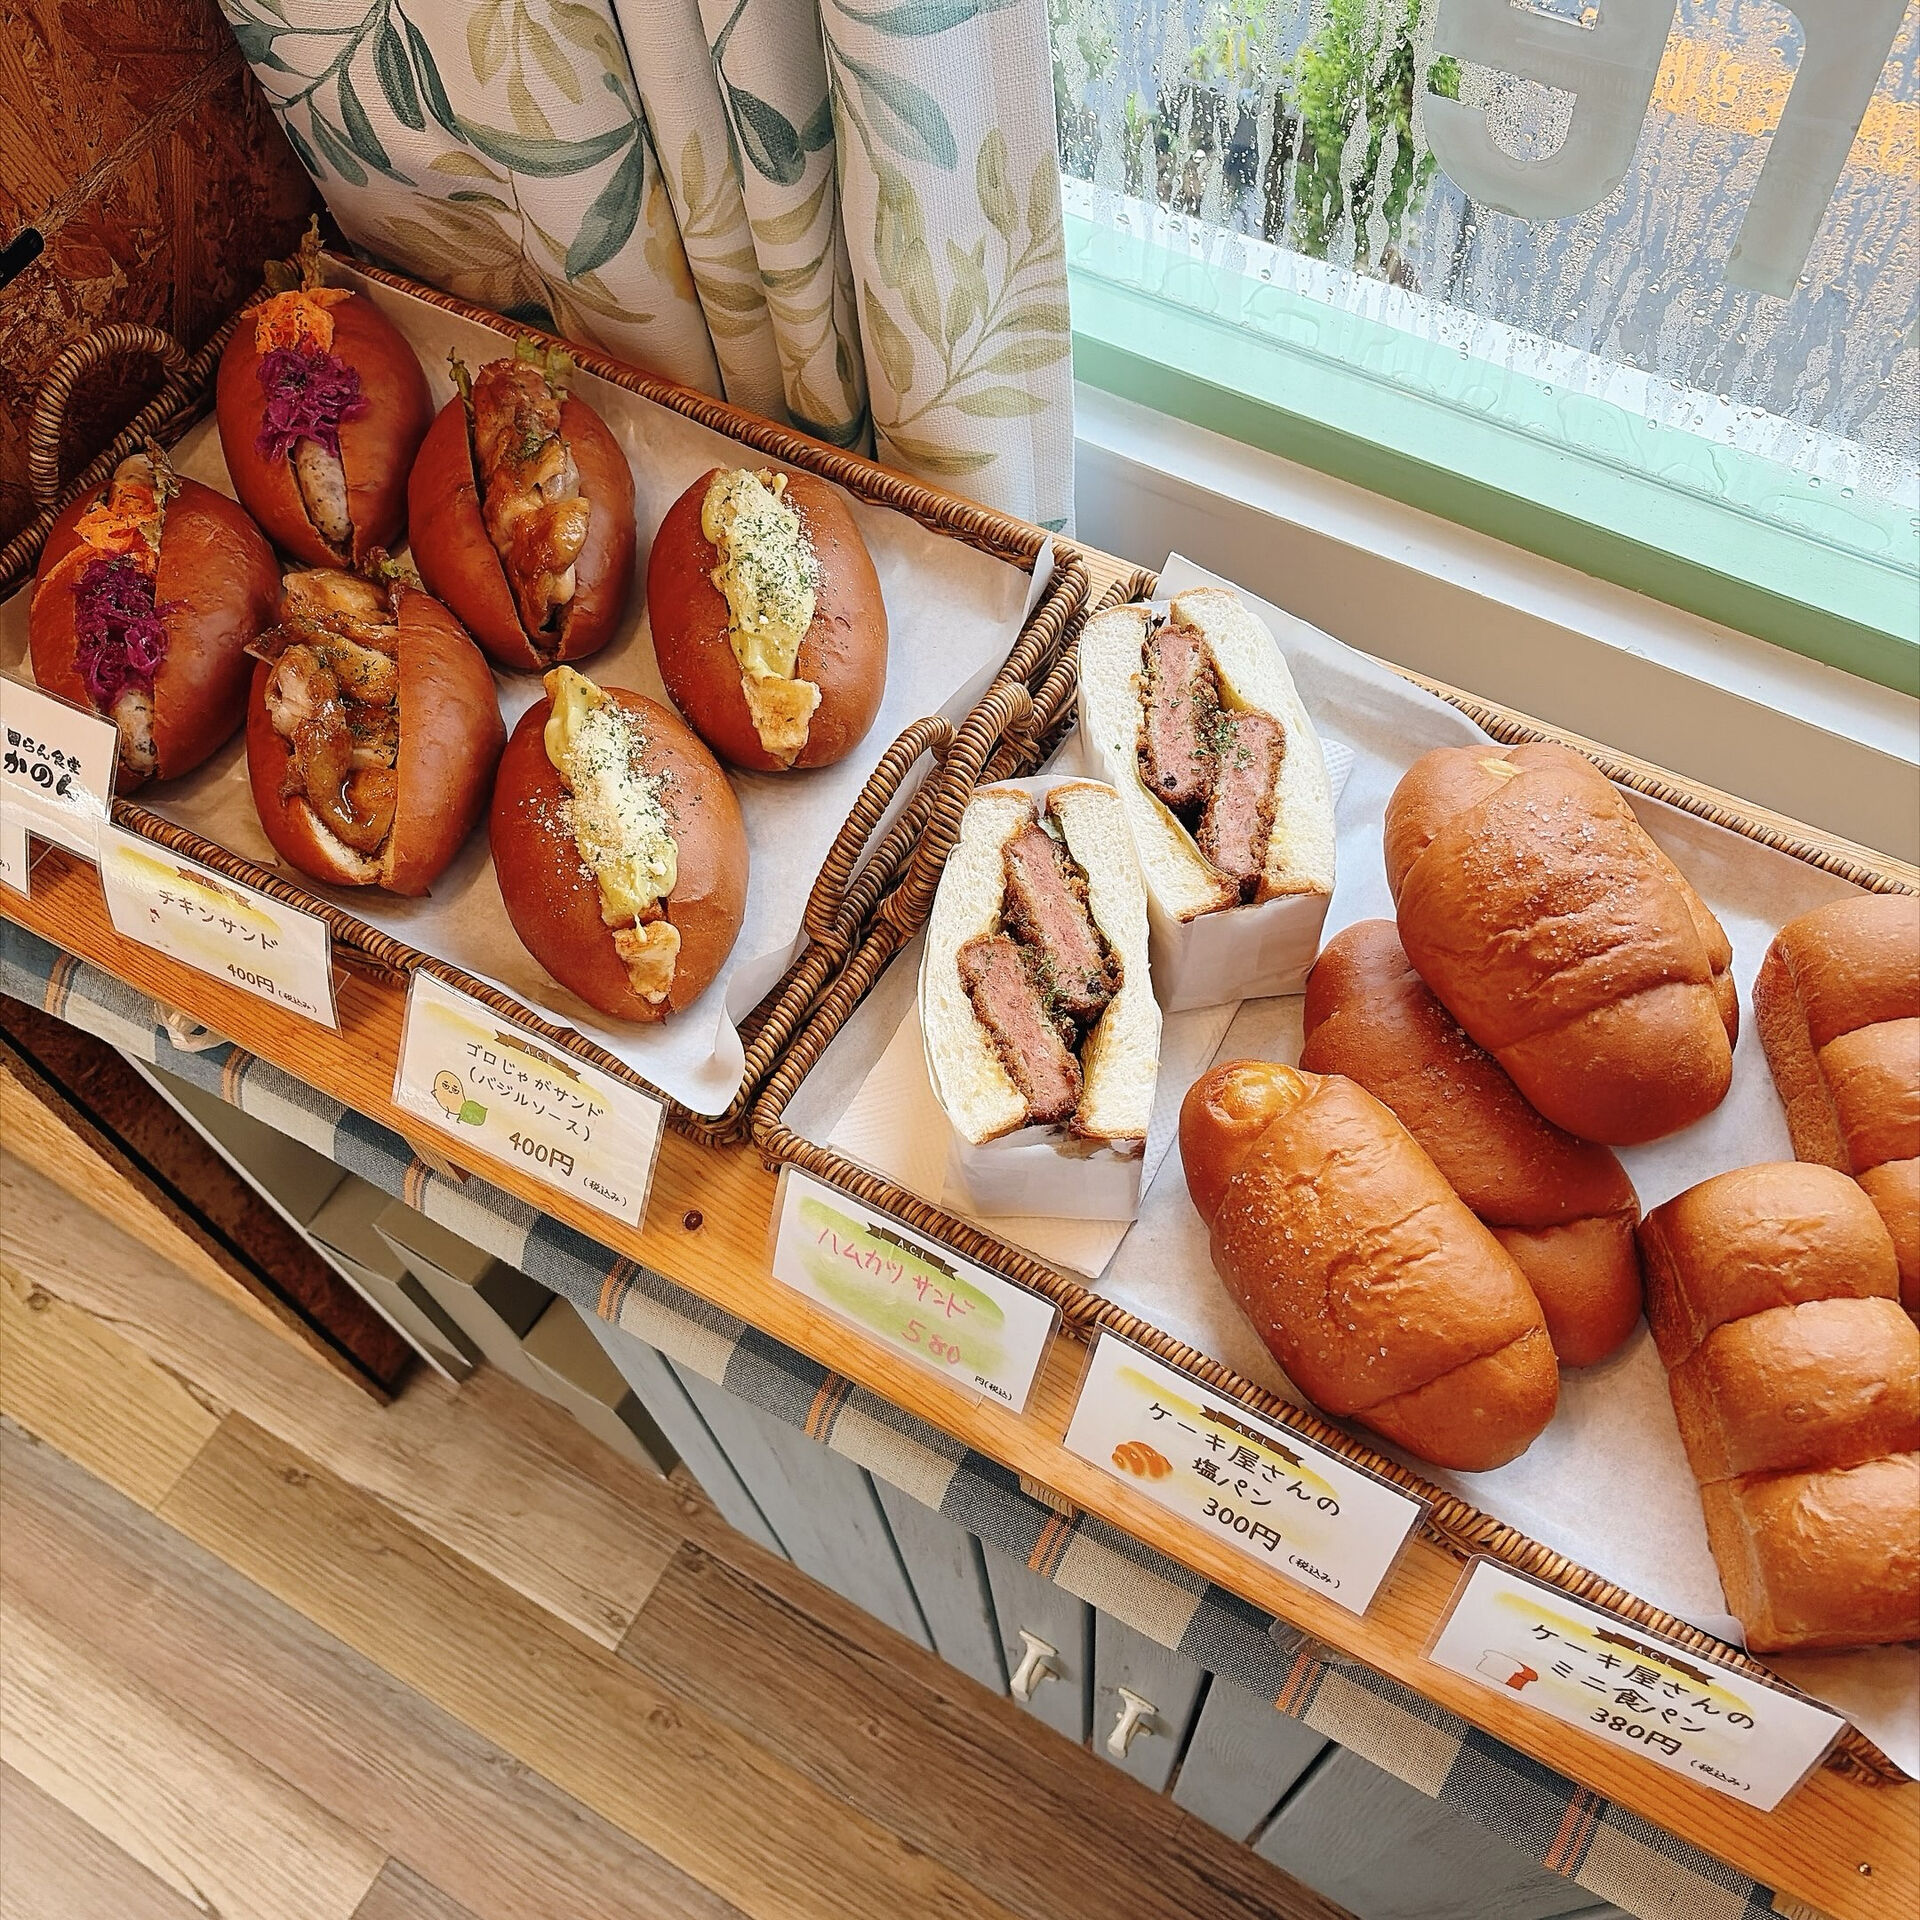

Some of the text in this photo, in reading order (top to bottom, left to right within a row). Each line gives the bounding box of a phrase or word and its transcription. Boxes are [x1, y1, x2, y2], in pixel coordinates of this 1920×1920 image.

[3, 750, 78, 801] かのん
[158, 889, 279, 951] チキンサンド
[227, 964, 274, 994] 400円
[466, 1042, 604, 1118] ゴロじゃがサンド
[469, 1066, 592, 1141] (バジルソース)
[509, 1131, 627, 1206] 400円 (税込み)
[1149, 1402, 1340, 1517] ケーキ屋さんの
[1191, 1457, 1272, 1507] 塩パン
[1203, 1497, 1342, 1589] 300円 (税込み)
[1531, 1624, 1755, 1730] ケーキ屋さんの
[1551, 1660, 1706, 1735] ミニ食パン
[1590, 1708, 1751, 1792] 380円 (税込み)
